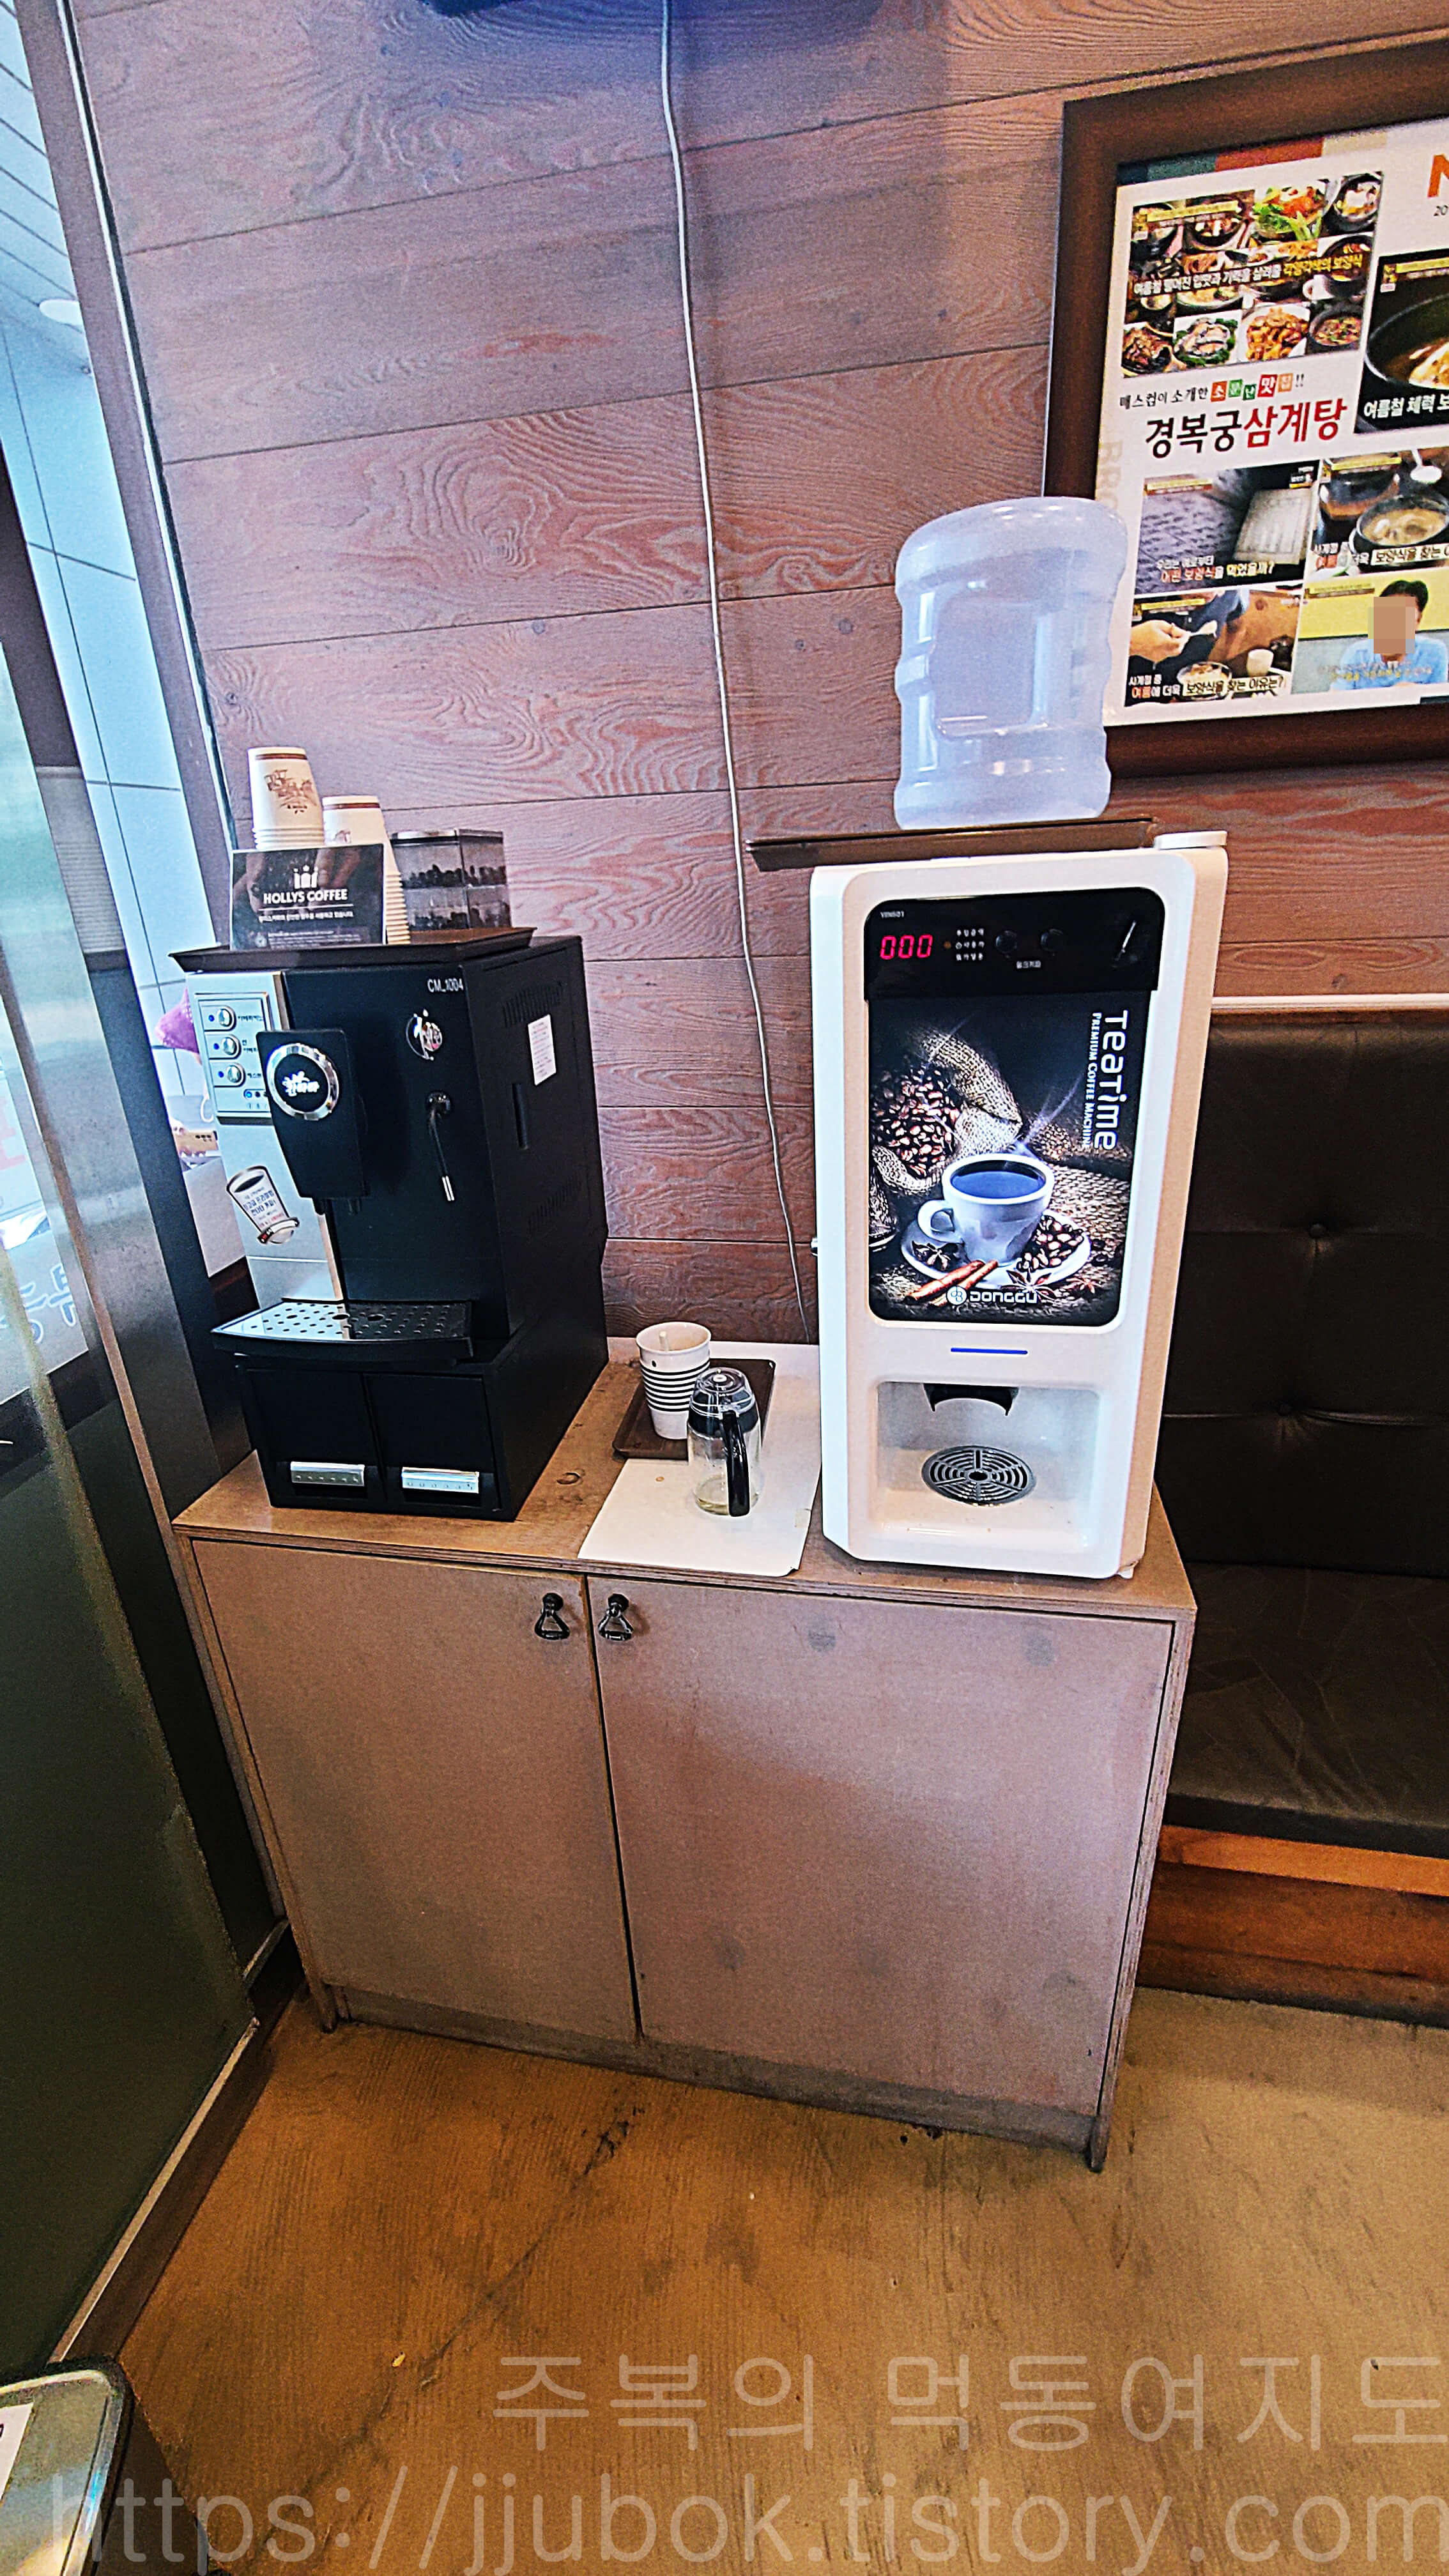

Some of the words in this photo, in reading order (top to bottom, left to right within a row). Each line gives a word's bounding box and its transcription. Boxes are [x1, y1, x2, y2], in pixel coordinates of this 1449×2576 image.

[1120, 392, 1167, 410] 매스컴이
[1170, 387, 1208, 402] 소개한
[1211, 379, 1257, 401] 소문난
[1363, 397, 1404, 419] 여름철
[1406, 394, 1436, 414] 체력
[1146, 398, 1347, 458] 경복궁삼계탕
[1376, 547, 1416, 563] 보양식을
[1420, 546, 1441, 559] 찾는
[1132, 686, 1161, 698] 여름에
[1163, 684, 1181, 696] 더욱
[1186, 680, 1225, 694] 보양식을
[1227, 678, 1246, 691] 찾는
[1249, 676, 1284, 689] 이유는?
[263, 891, 305, 905] HOLLYS
[307, 889, 348, 902] COFFEE
[880, 934, 933, 960] 000
[427, 977, 464, 992] CM_1004
[1089, 1012, 1102, 1061] PREMIUM
[1085, 1062, 1098, 1100] COFFEE
[1082, 1102, 1095, 1149] MACHINE
[969, 1290, 1038, 1304] DONGGU
